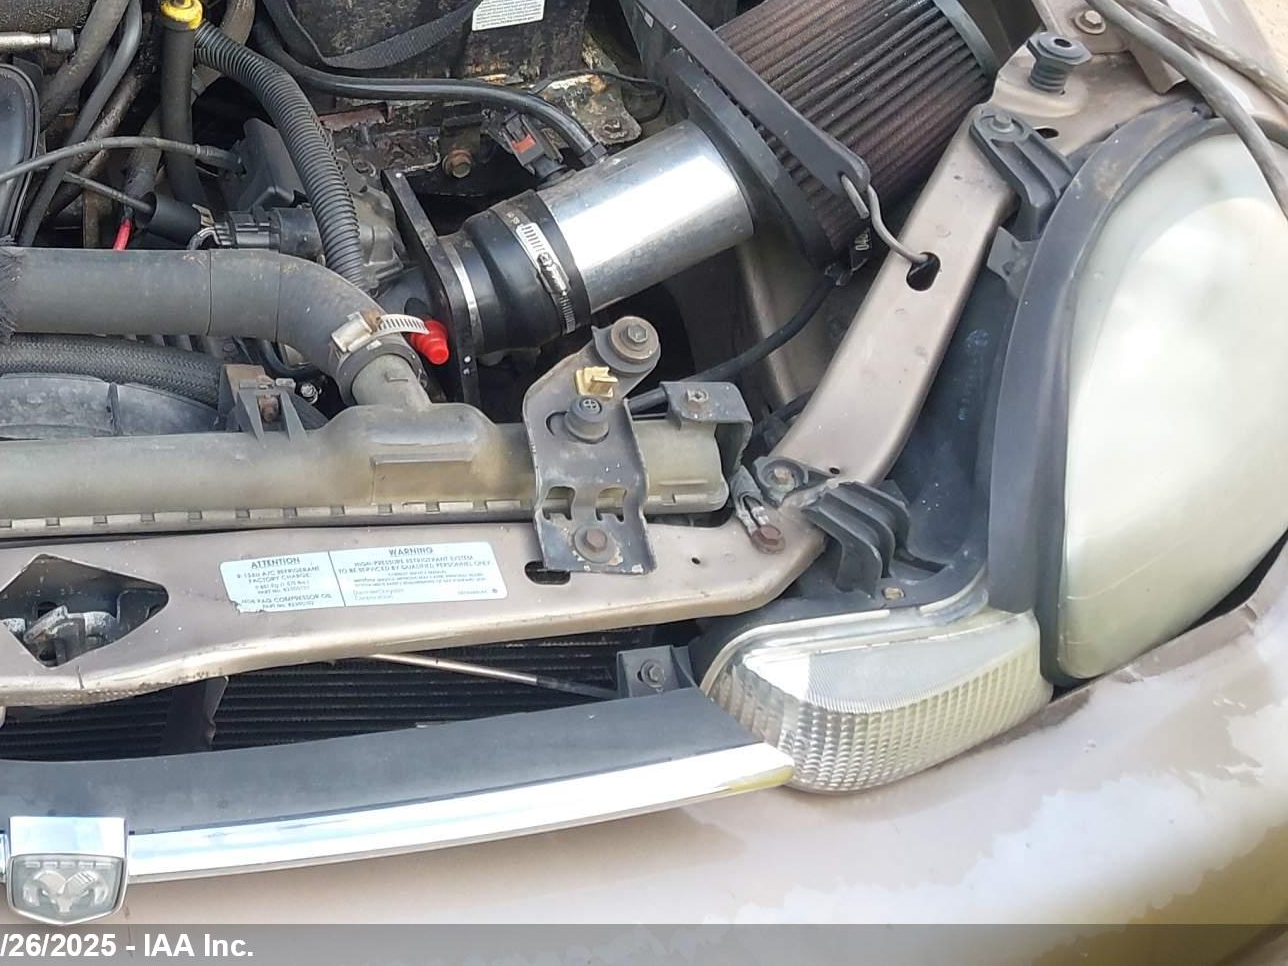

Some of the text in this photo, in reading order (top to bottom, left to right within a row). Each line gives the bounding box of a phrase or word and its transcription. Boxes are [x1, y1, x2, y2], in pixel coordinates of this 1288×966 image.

[388, 546, 434, 557] WARNING
[251, 557, 301, 569] ATTENTION
[248, 574, 280, 584] FACTORY
